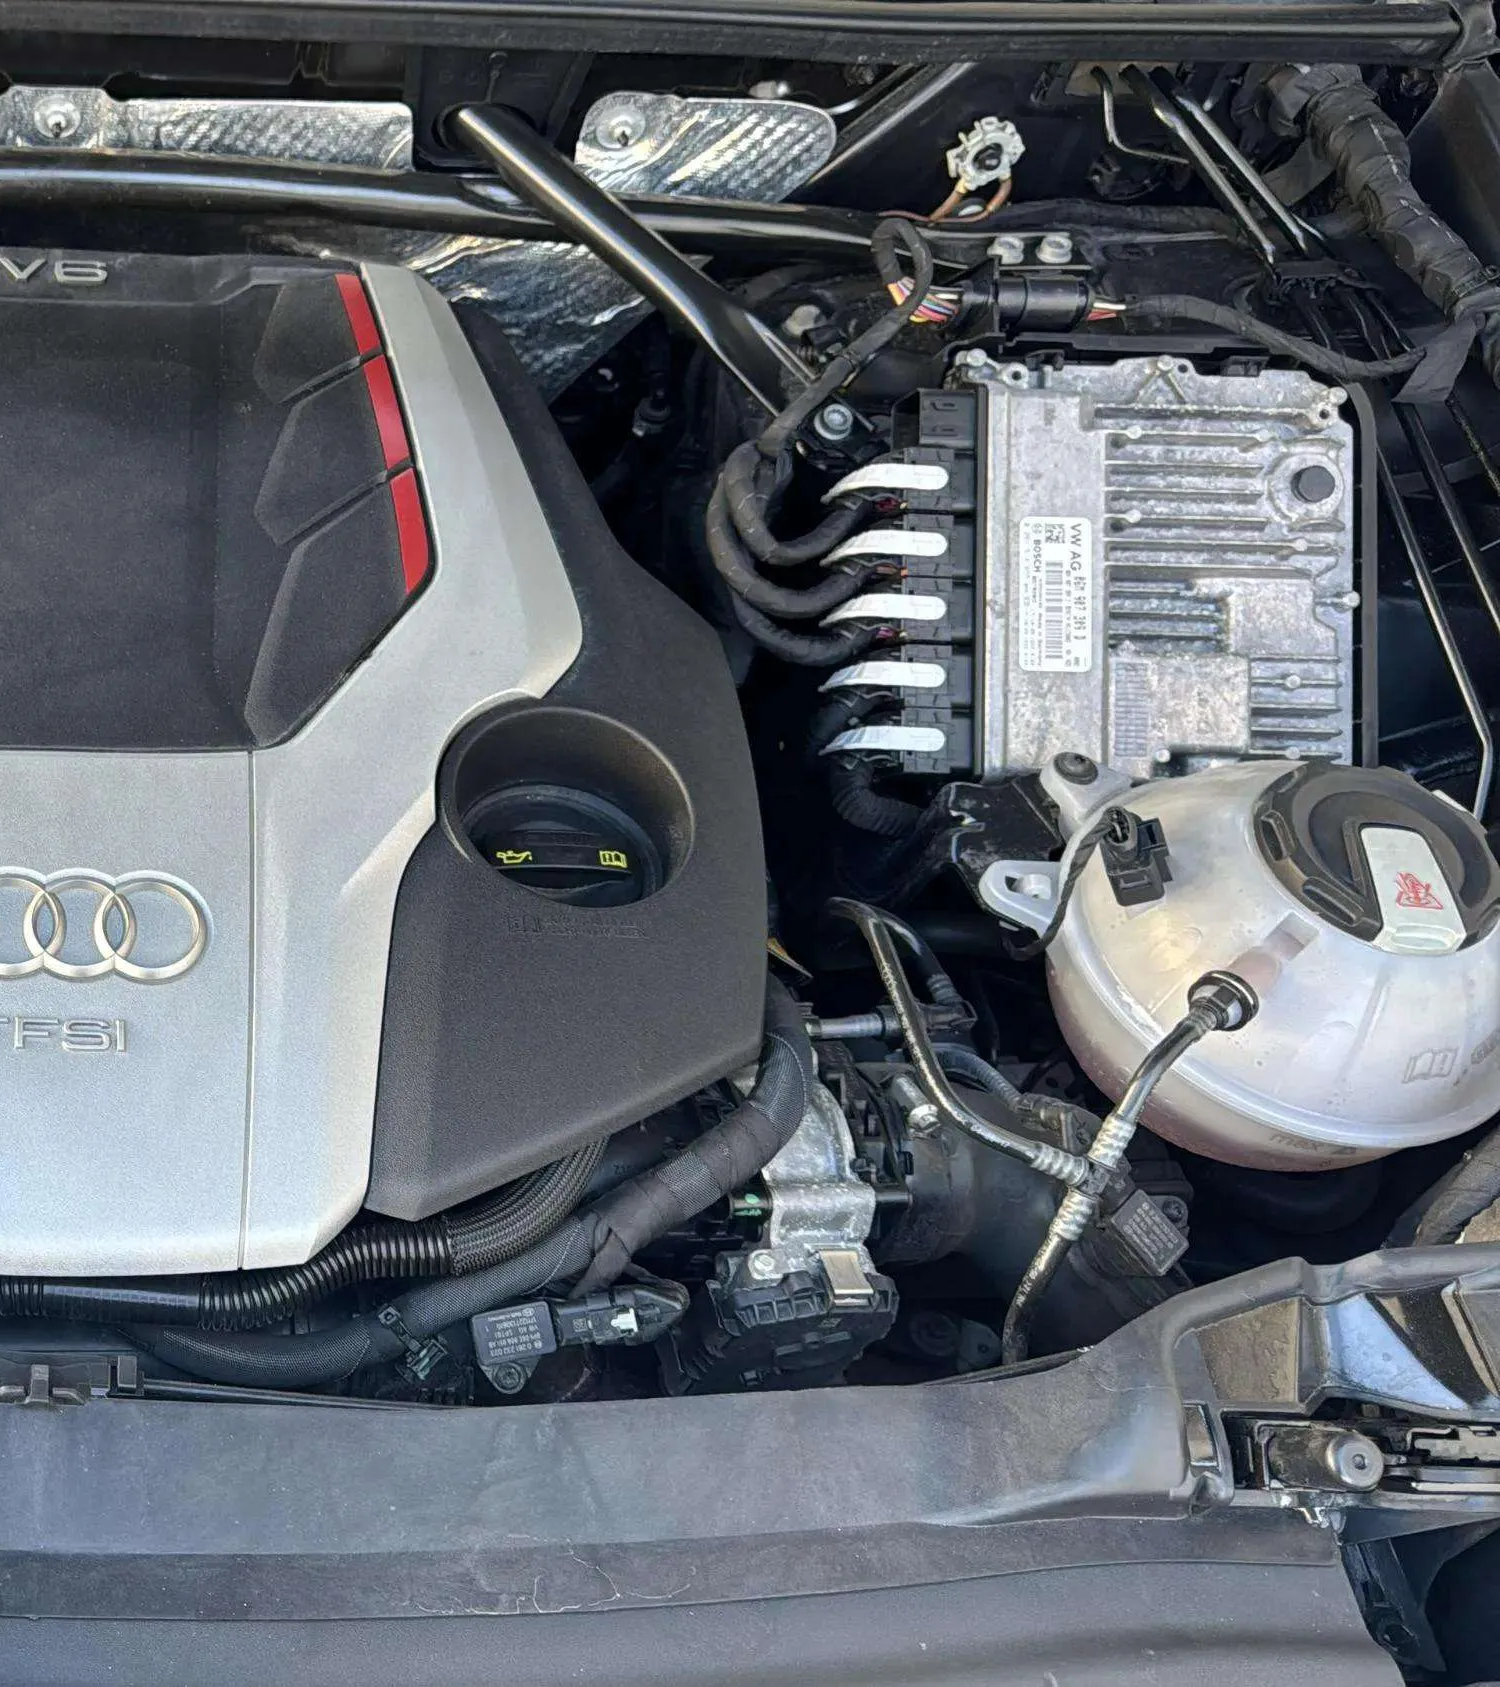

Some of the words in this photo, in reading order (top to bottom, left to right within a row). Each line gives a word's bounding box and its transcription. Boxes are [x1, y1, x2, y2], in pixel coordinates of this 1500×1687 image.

[1070, 523, 1082, 547] VW
[1033, 539, 1042, 573] BOSCH
[1070, 550, 1082, 571] AG
